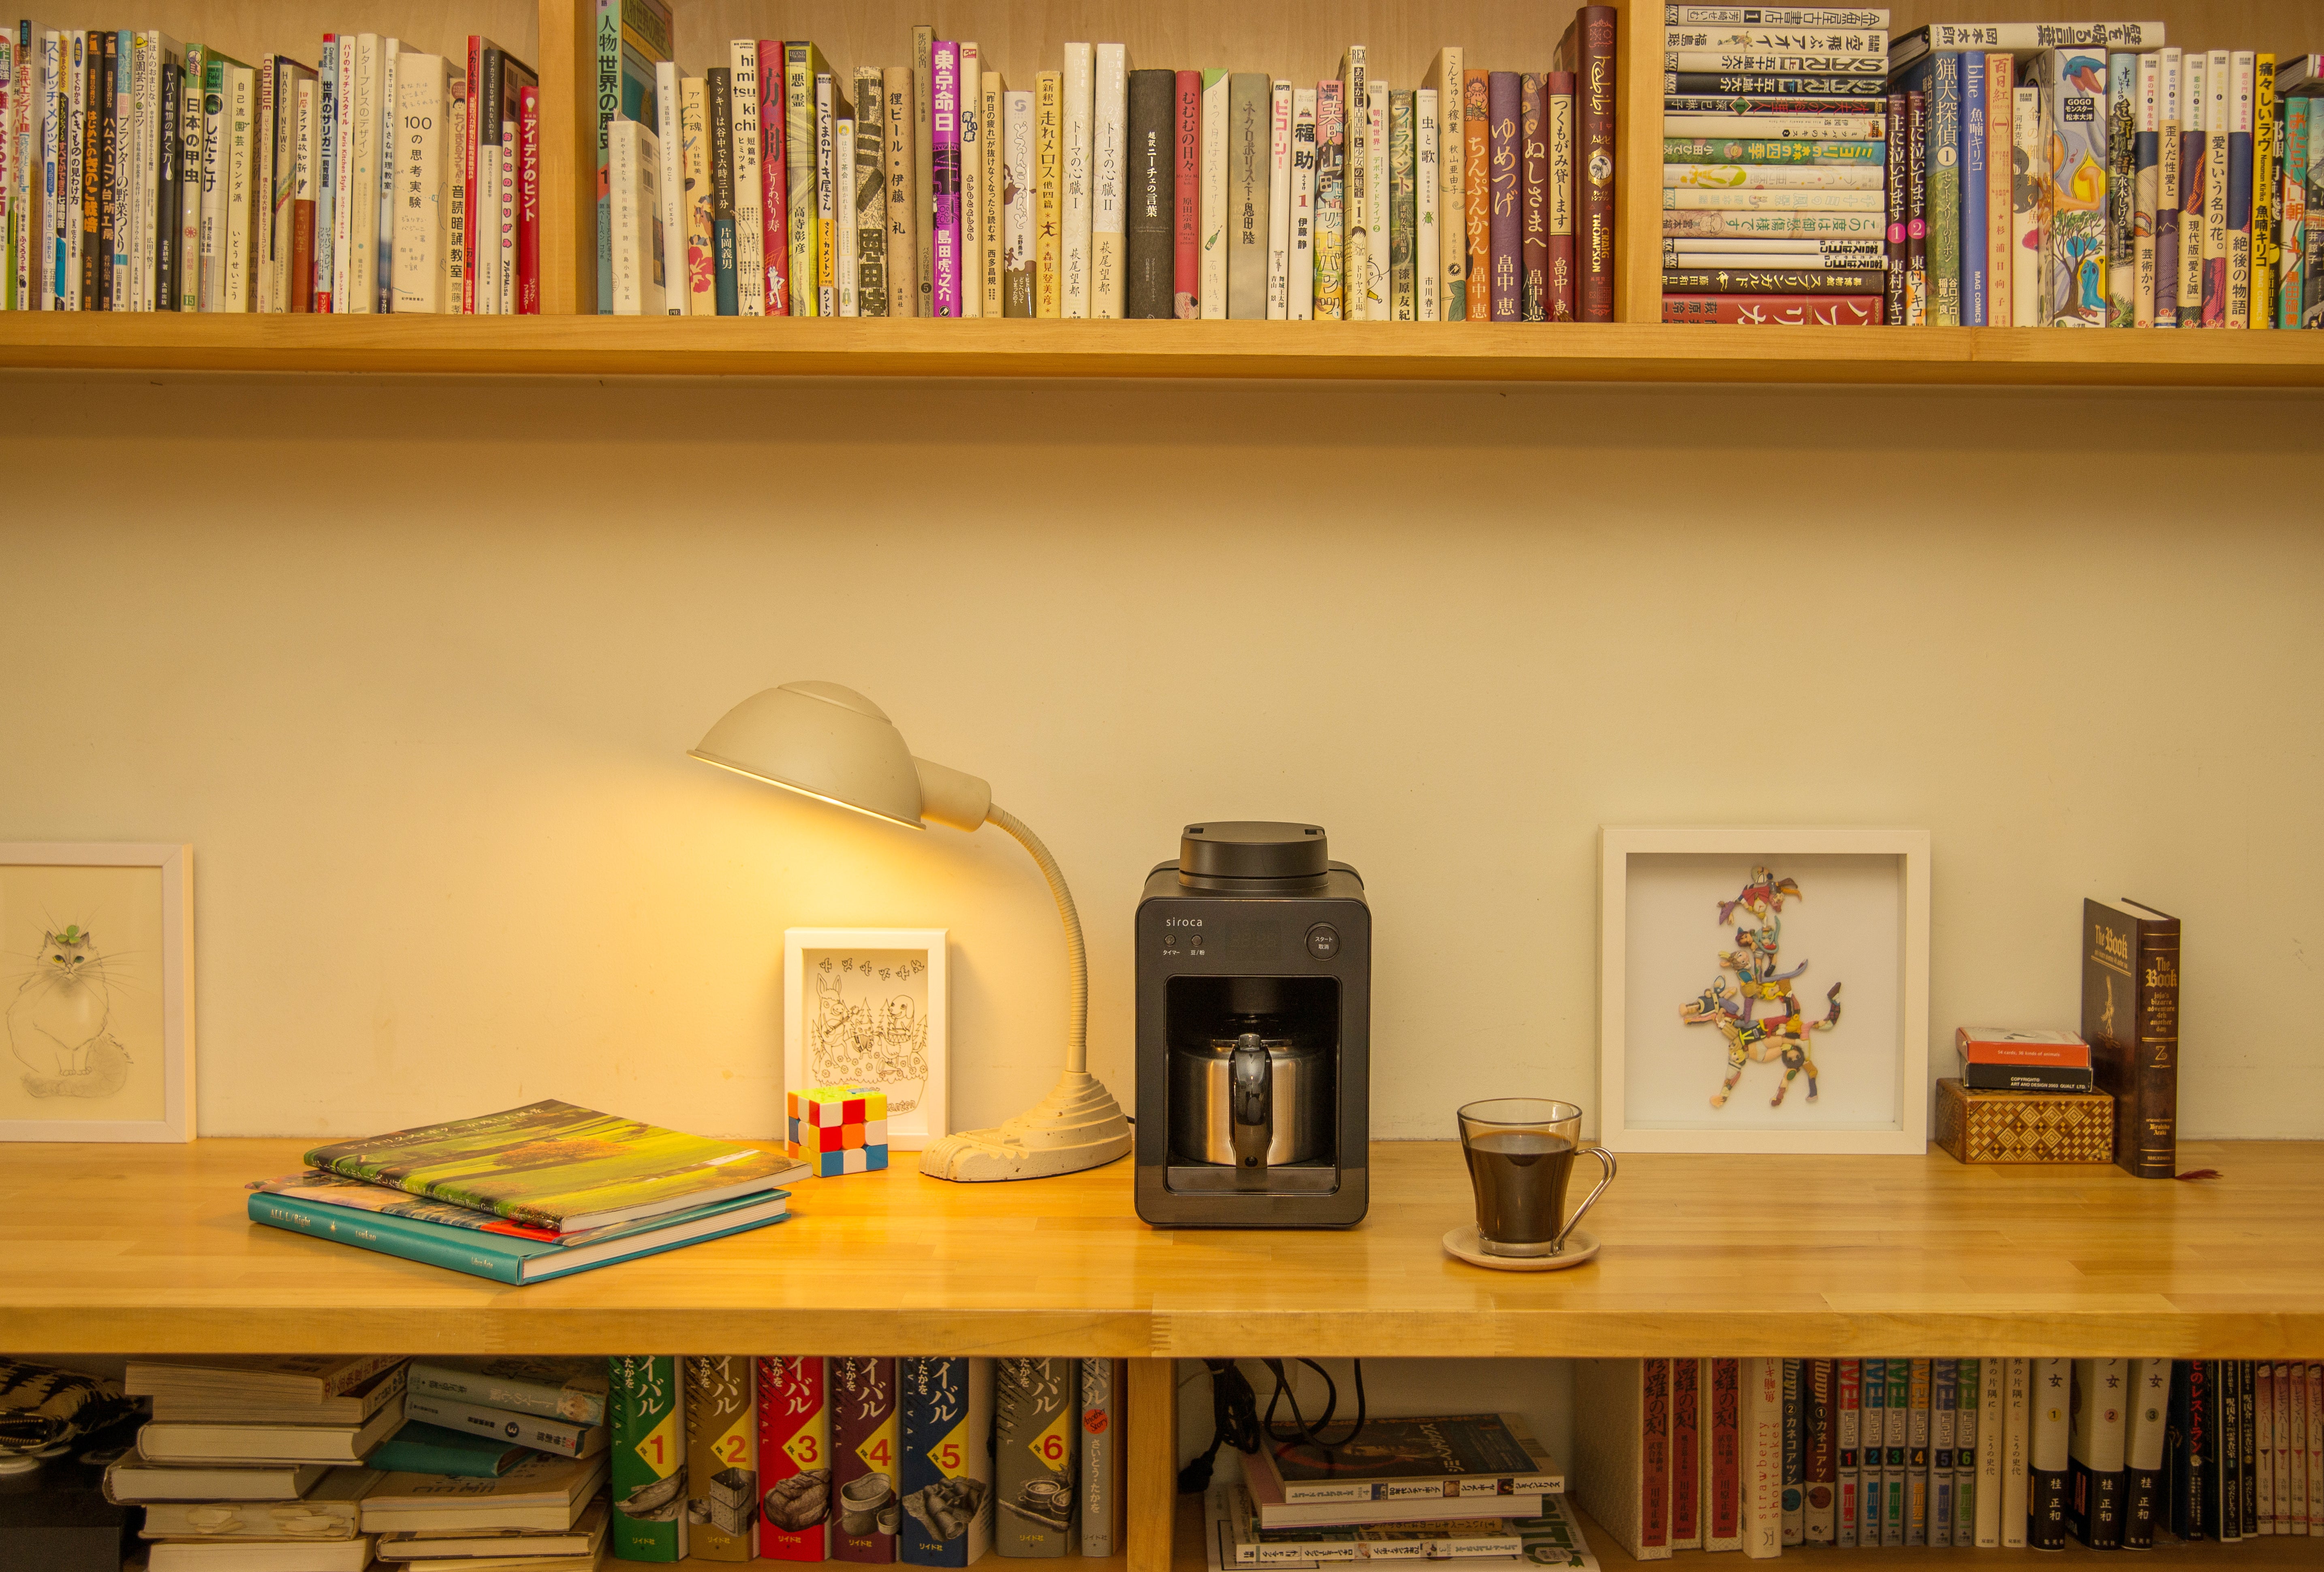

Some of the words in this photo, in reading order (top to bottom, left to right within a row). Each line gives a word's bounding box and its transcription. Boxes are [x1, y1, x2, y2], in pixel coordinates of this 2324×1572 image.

[1668, 32, 1708, 47] 福島聡
[1757, 34, 1863, 50] 空飛ぶアオイ
[1764, 10, 1880, 27] 金魚屋古書店
[1941, 25, 1999, 47] 岡本太郎
[147, 37, 157, 108] にほんのおまじない
[741, 54, 754, 67] hi
[918, 33, 927, 68] 死の同心円
[1352, 49, 1366, 60] REX
[1721, 56, 1777, 71] 五十嵐大介
[46, 41, 60, 157] ストレッチ・メソッド
[135, 49, 146, 127] 苔園芸コツのコツ
[263, 60, 272, 110] CONTINUE
[280, 71, 289, 114] HAPPY
[340, 44, 351, 126] パリのキッチンスタイル
[358, 45, 372, 158] レタープレスのデザイン
[468, 49, 477, 136] バカ日本地図
[791, 73, 805, 108] 悪霊
[935, 49, 954, 131] 東京命日
[1448, 55, 1460, 134] こんちゅう稼業
[1720, 77, 1775, 93] 五十嵐大介
[1935, 58, 1958, 146] 猟犬探偵
[1967, 65, 1984, 99] blue
[1993, 58, 2009, 101] 百日紅
[688, 93, 703, 133] アロハ魂
[735, 120, 756, 133] chi
[743, 103, 756, 115] ki
[962, 111, 978, 142] 青い車
[1182, 92, 1196, 171] むむむの日々
[1354, 66, 1364, 198] あやかし古書庫と少女の魅宝
[1372, 109, 1381, 152] 朝倉世界一
[2065, 113, 2093, 122] 松本大洋
[2257, 62, 2273, 152] 痛々しいラヴ
[70, 109, 84, 205] やきものの見わけ方
[184, 97, 201, 184] 日本の甲虫
[203, 118, 218, 193] しだ・こけ
[233, 82, 250, 203] 自己流園芸ベランダ派
[280, 118, 288, 152] NEWS
[321, 81, 334, 188] 世界のザリガニ飼育図鑑
[384, 111, 394, 190] ちいさな料理教室
[715, 77, 729, 209] ミッキーは谷中で六時三十分
[820, 101, 832, 212] こぐまのケーキ屋さん
[1040, 111, 1056, 179] 走れメロス
[1069, 121, 1083, 196] トーマの心臓
[1101, 121, 1116, 197] トーマの心臓
[1243, 101, 1257, 183] ネクロポリス
[1294, 123, 1316, 170] 福助
[1395, 105, 1411, 196] フィラメント
[1420, 116, 1435, 164] 虫と歌
[1748, 143, 1873, 160] ミヨリの森の四季
[1969, 107, 1984, 172] 魚喃キリコ
[83, 111, 98, 233] はじめてのきのこ栽培
[101, 117, 117, 240] ハム・ベーコン台所工房
[115, 116, 130, 253] プランターの野菜つくり
[502, 132, 513, 248] おとなのおりがみ
[522, 117, 536, 221] アイデアのヒント
[985, 91, 997, 242] 「昨日の疲れ」が抜けなくなったら読む本
[1145, 149, 1158, 218] ニーチェの言葉
[1491, 118, 1519, 218] ゆめつげ
[1553, 100, 1569, 230] つくもがみ貸します
[1888, 114, 1905, 221] 主に泣いてます
[1908, 110, 1925, 217] 主に泣いてます
[768, 164, 780, 232] しりあがり寿
[965, 174, 975, 241] よしもとよしとも
[1042, 181, 1054, 209] 他四篇
[1182, 197, 1193, 231] 原田宗典
[1467, 137, 1489, 256] ちんぷんかん
[1523, 139, 1546, 248] ぬしさまへ
[2117, 177, 2128, 227] 水木しげる
[2210, 135, 2226, 250] 愛という名の花。
[261, 177, 269, 265] 僕たちの大好きなファミコン100
[450, 185, 464, 278] 音読暗誦教室
[795, 206, 806, 255] 高寺彰彦
[1241, 202, 1256, 246] 恩田陸
[1591, 213, 1601, 273] THOMPSON
[1725, 218, 1876, 232] この度は御愁傷様です
[2255, 205, 2269, 268] 魚喃キリコ
[146, 237, 154, 269] 広田千悦子
[231, 231, 240, 301] いとうせいこう
[720, 227, 733, 269] 片岡義男
[937, 230, 952, 301] 島田虎之介
[1068, 248, 1081, 297] 萩尾望都
[1098, 240, 1113, 295] 萩尾望都
[2141, 248, 2153, 296] 芸術か？
[2186, 220, 2200, 301] 現代版『愛と誠』
[1042, 251, 1054, 305] 森見登美彦
[1209, 260, 1220, 314] 石持浅海
[1355, 265, 1364, 312] ドリヤス工場
[1398, 268, 1411, 321] 漆原友紀
[1424, 276, 1434, 318] 市川春子
[1736, 274, 1821, 291] スプリンガルド
[1889, 260, 1904, 326] 東村アキコ
[1909, 256, 1925, 319] 東村アキコ
[1948, 276, 1958, 325] 谷口ジロー
[2231, 237, 2248, 316] 絶後の物語
[2285, 271, 2299, 327] 黒田硫黄
[1166, 918, 1203, 927] siroca
[2095, 924, 2105, 947] The
[2105, 926, 2128, 960] Book
[2145, 969, 2178, 988] Book
[2155, 956, 2171, 972] The
[2154, 992, 2170, 1000] jojo's
[448, 1194, 466, 1206] Beatrix
[466, 1198, 481, 1211] Potter
[480, 1203, 494, 1214] Gave
[650, 1435, 664, 1465] 1
[726, 1435, 747, 1463] 2
[797, 1435, 818, 1463] 3
[869, 1439, 891, 1467] 4
[941, 1444, 961, 1469] 5
[1043, 1435, 1063, 1460] 6
[1756, 1422, 1770, 1520] strawberry
[1769, 1422, 1779, 1519] shortcakes
[1785, 1417, 1797, 1485] カネコアツシ
[1986, 1435, 1995, 1476] こうの史代
[2012, 1435, 2021, 1476] こうの史代
[2049, 1478, 2062, 1521] 桂正和
[2100, 1479, 2113, 1521] 桂正和
[2138, 1477, 2152, 1519] 桂正和
[632, 1537, 656, 1545] リイド社
[707, 1536, 731, 1544] リイド社
[777, 1536, 801, 1544] リイド社
[919, 1543, 943, 1551] リイド社
